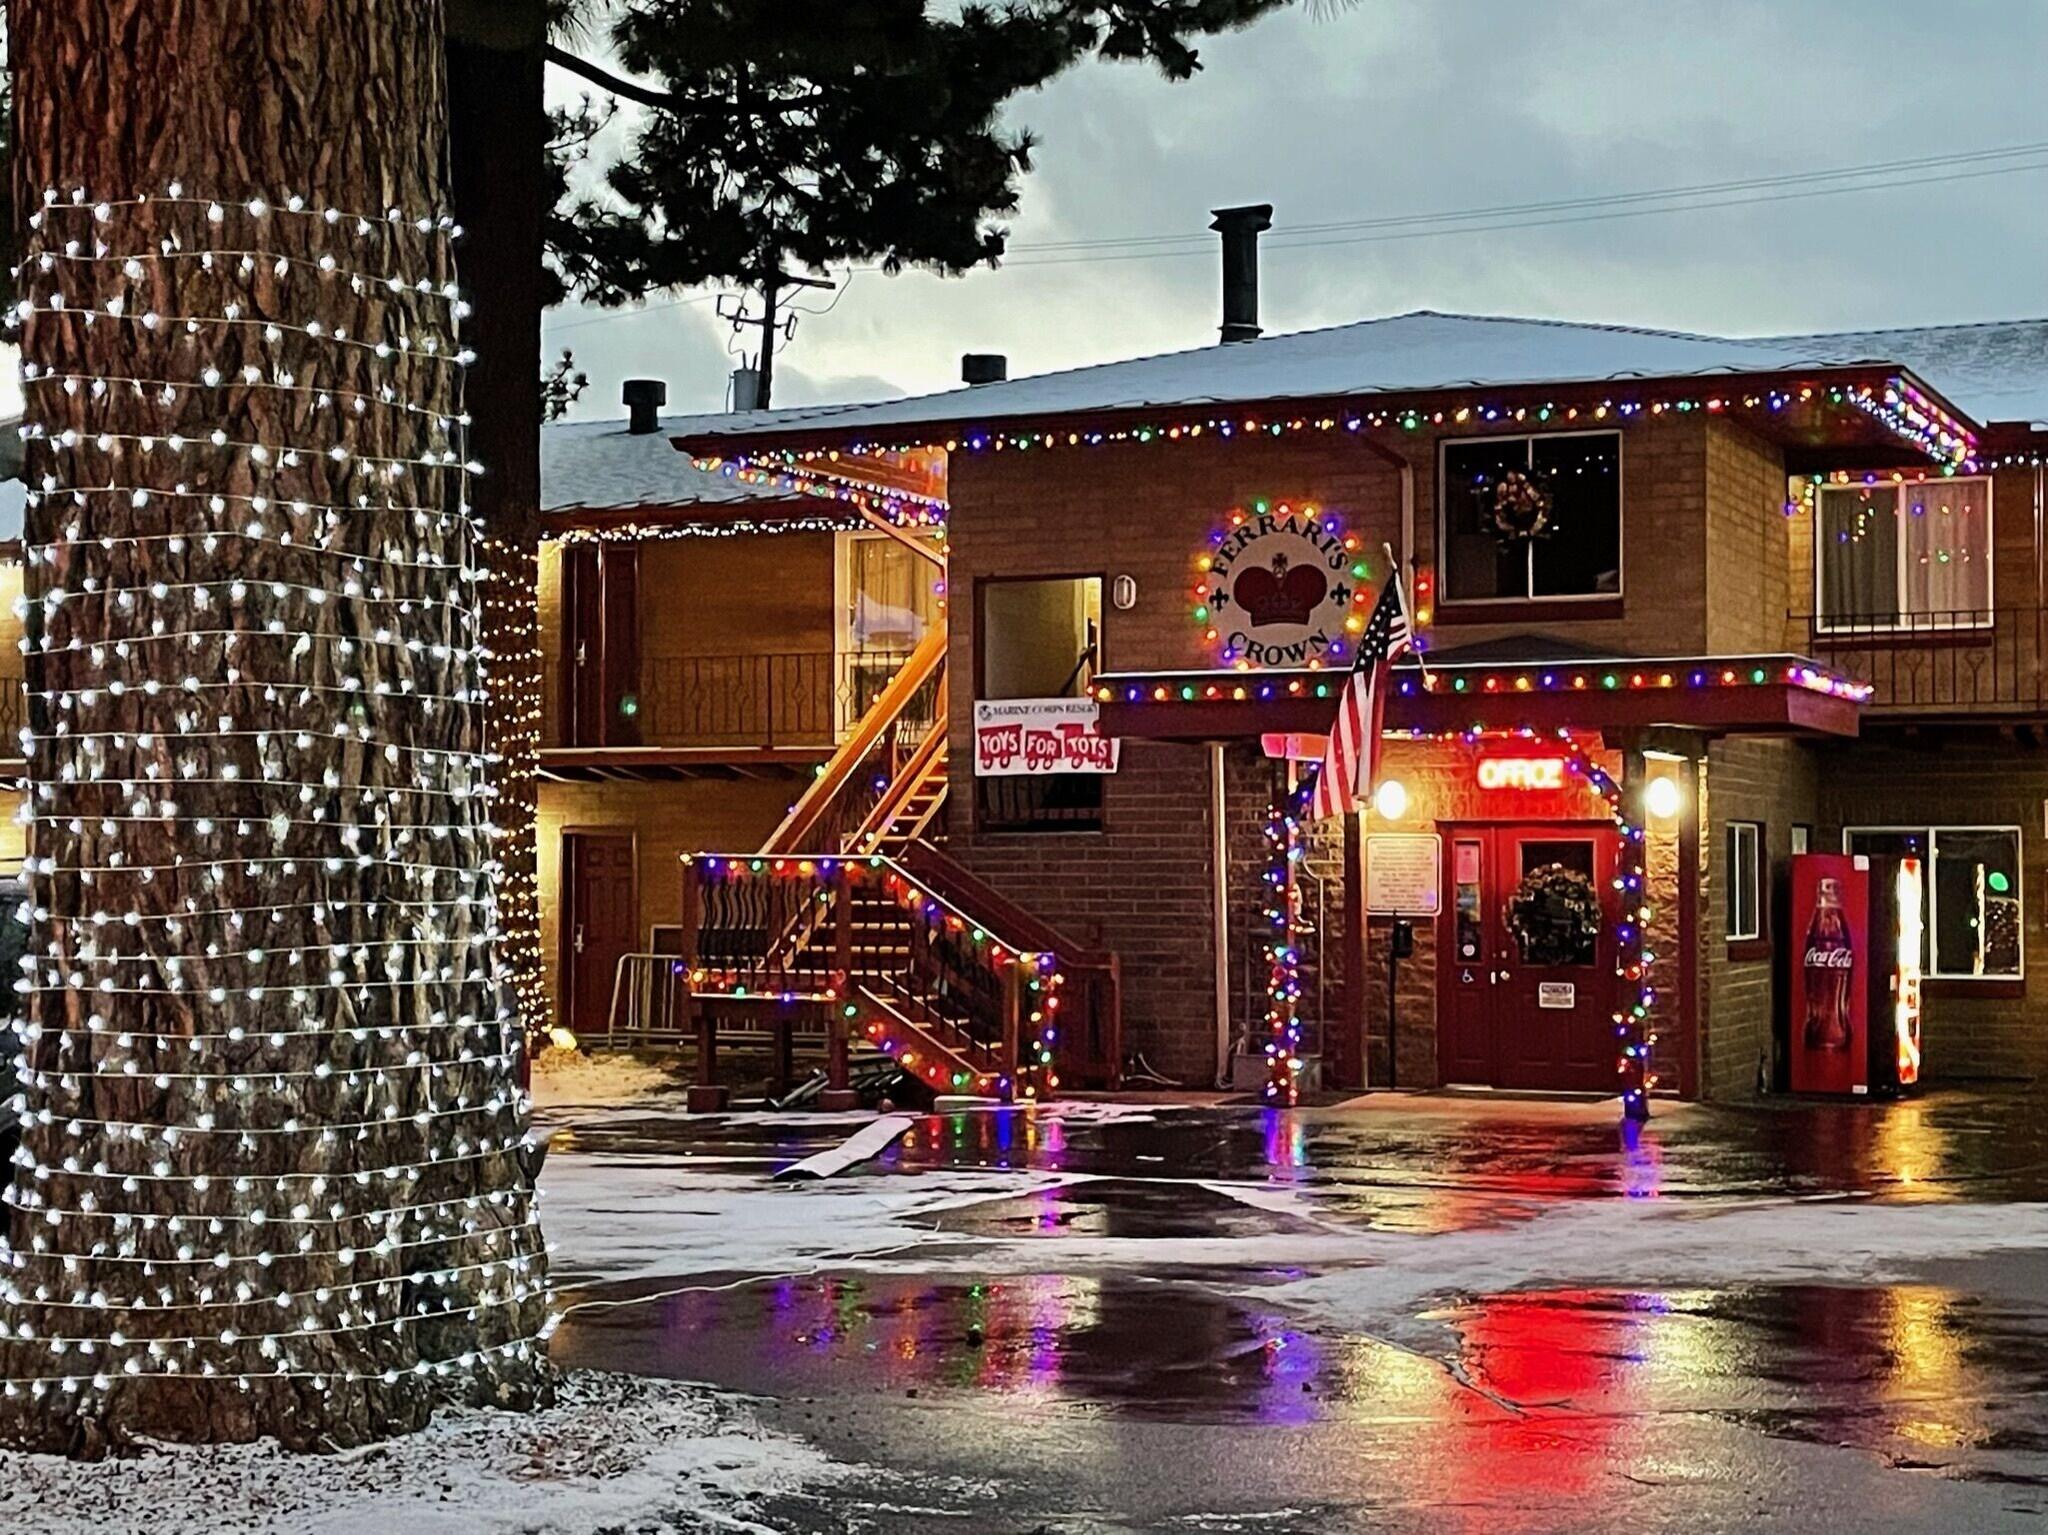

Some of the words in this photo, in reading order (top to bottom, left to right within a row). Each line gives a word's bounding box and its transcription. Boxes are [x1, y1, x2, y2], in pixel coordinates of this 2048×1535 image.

[1210, 515, 1348, 578] FERRARI'S
[1227, 628, 1330, 666] CROWN
[993, 705, 1030, 716] MARINE
[1032, 704, 1064, 714] CORPS
[981, 730, 1018, 755] TOYS
[1026, 735, 1057, 756] FOR
[1066, 737, 1108, 758] TOYS
[1478, 759, 1564, 789] OFFICE
